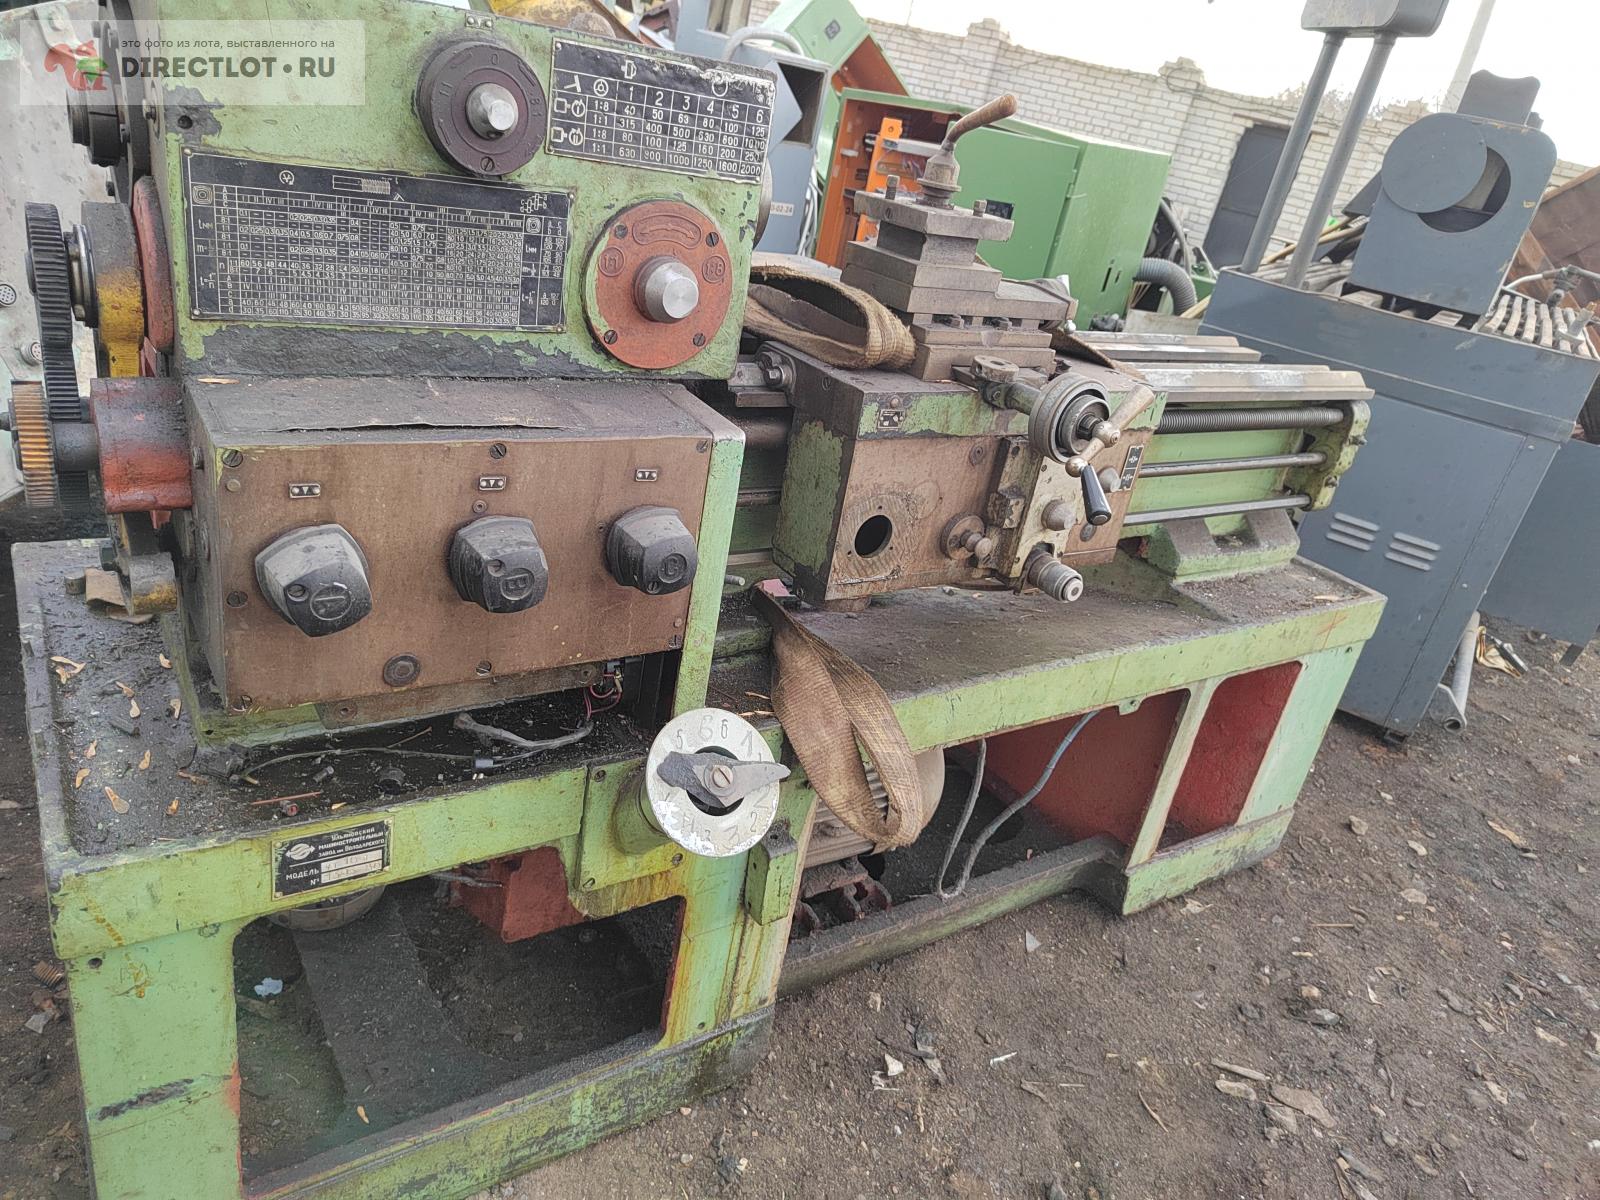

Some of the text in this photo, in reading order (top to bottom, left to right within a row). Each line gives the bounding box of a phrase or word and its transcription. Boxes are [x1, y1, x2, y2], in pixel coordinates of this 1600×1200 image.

[594, 100, 766, 138] 1:8 40 50 63 80 100 125
[629, 86, 764, 123] 1 2 3 4 5 6
[594, 114, 608, 126] 1:1
[620, 118, 636, 130] 315
[645, 122, 663, 134] 400
[672, 126, 691, 138] 500
[592, 128, 607, 140] 1:8
[622, 132, 633, 142] 80
[645, 136, 662, 148] 100
[673, 140, 687, 152] 125
[698, 144, 714, 156] 160
[720, 148, 736, 159] 200
[592, 142, 606, 154] 1:1
[619, 146, 636, 159] 630
[669, 154, 690, 166] 1000
[694, 158, 713, 170] 1250
[719, 160, 738, 172] 1600
[740, 163, 761, 175] 2000
[720, 718, 728, 740] 6
[286, 868, 320, 880] МОДЕЛЬ
